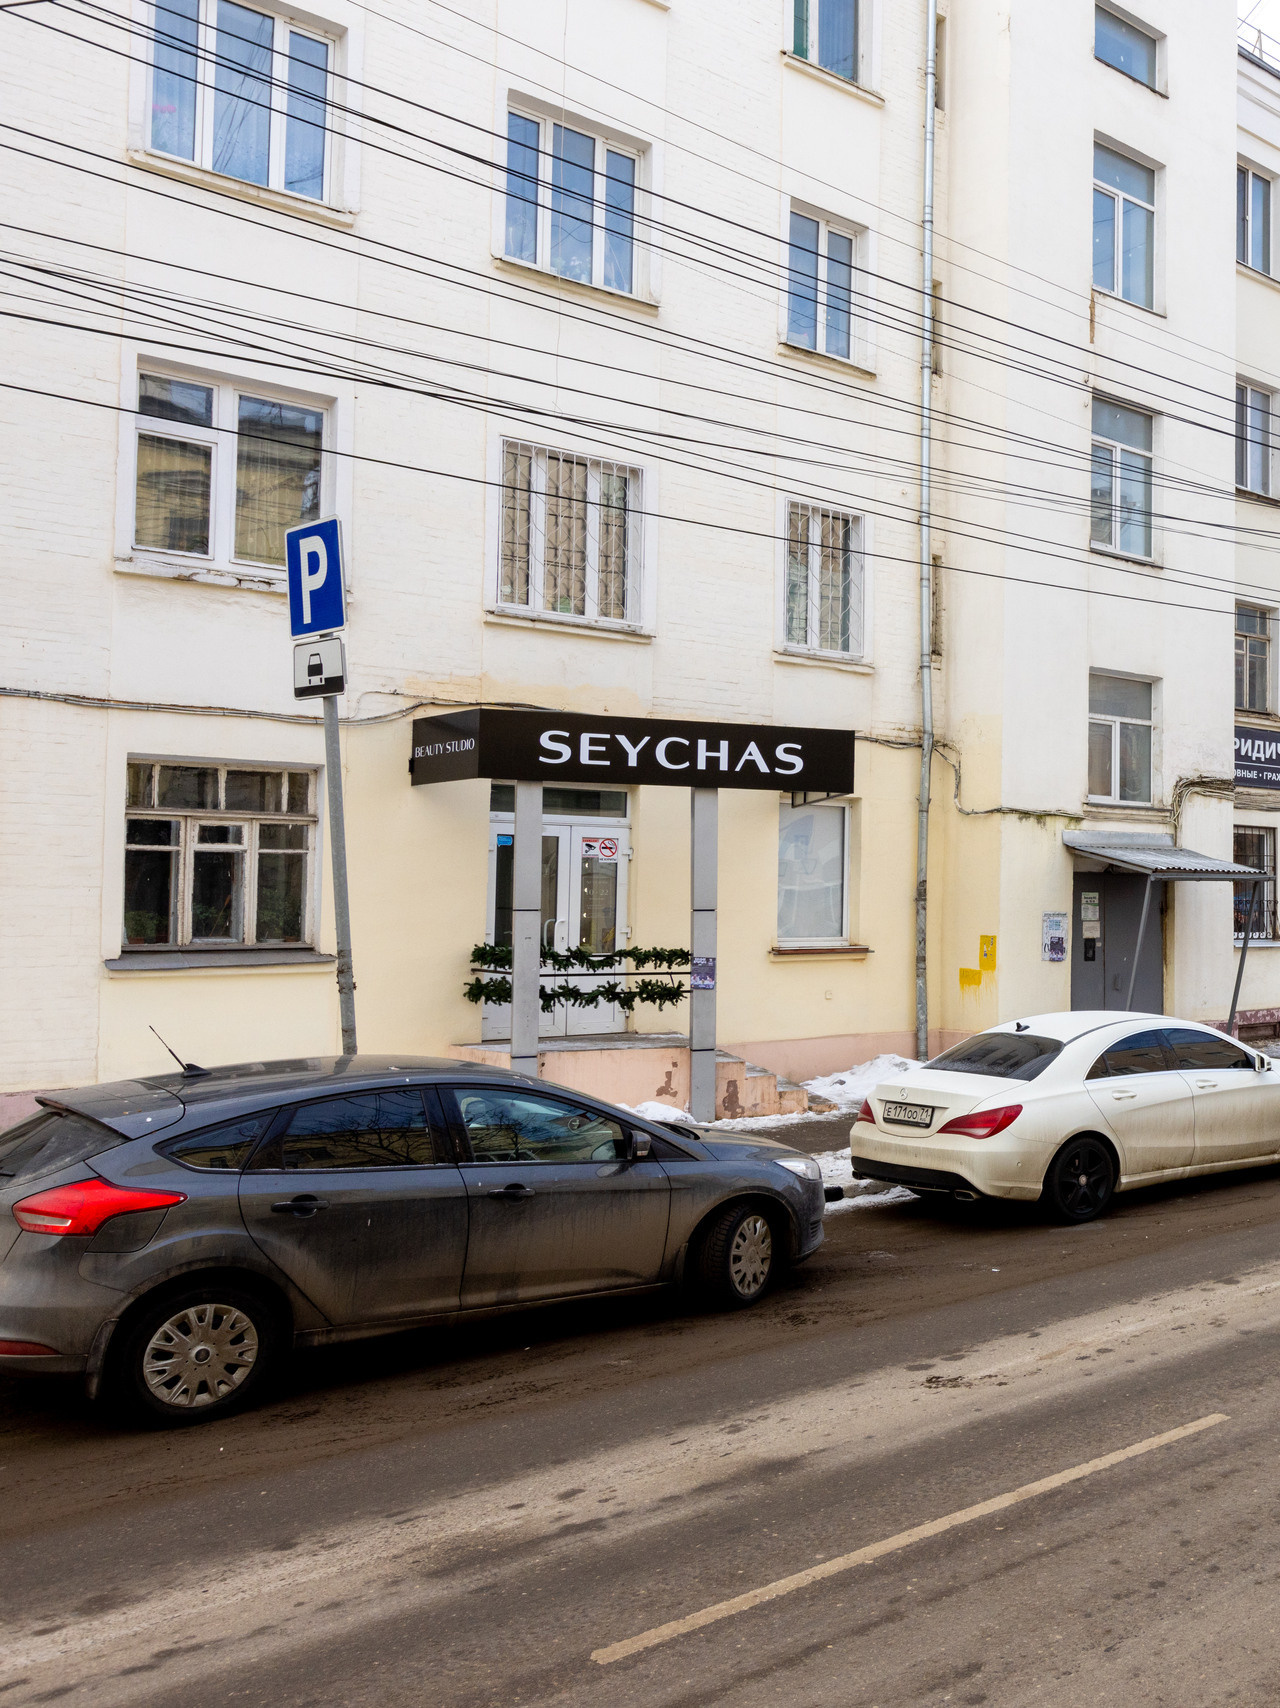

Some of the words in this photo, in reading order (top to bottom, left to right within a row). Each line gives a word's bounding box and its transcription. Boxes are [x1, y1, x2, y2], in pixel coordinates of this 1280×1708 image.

[299, 535, 328, 624] P
[415, 743, 444, 758] BEAUTY
[445, 738, 475, 753] STUDIO
[539, 730, 804, 775] SEYCHAS
